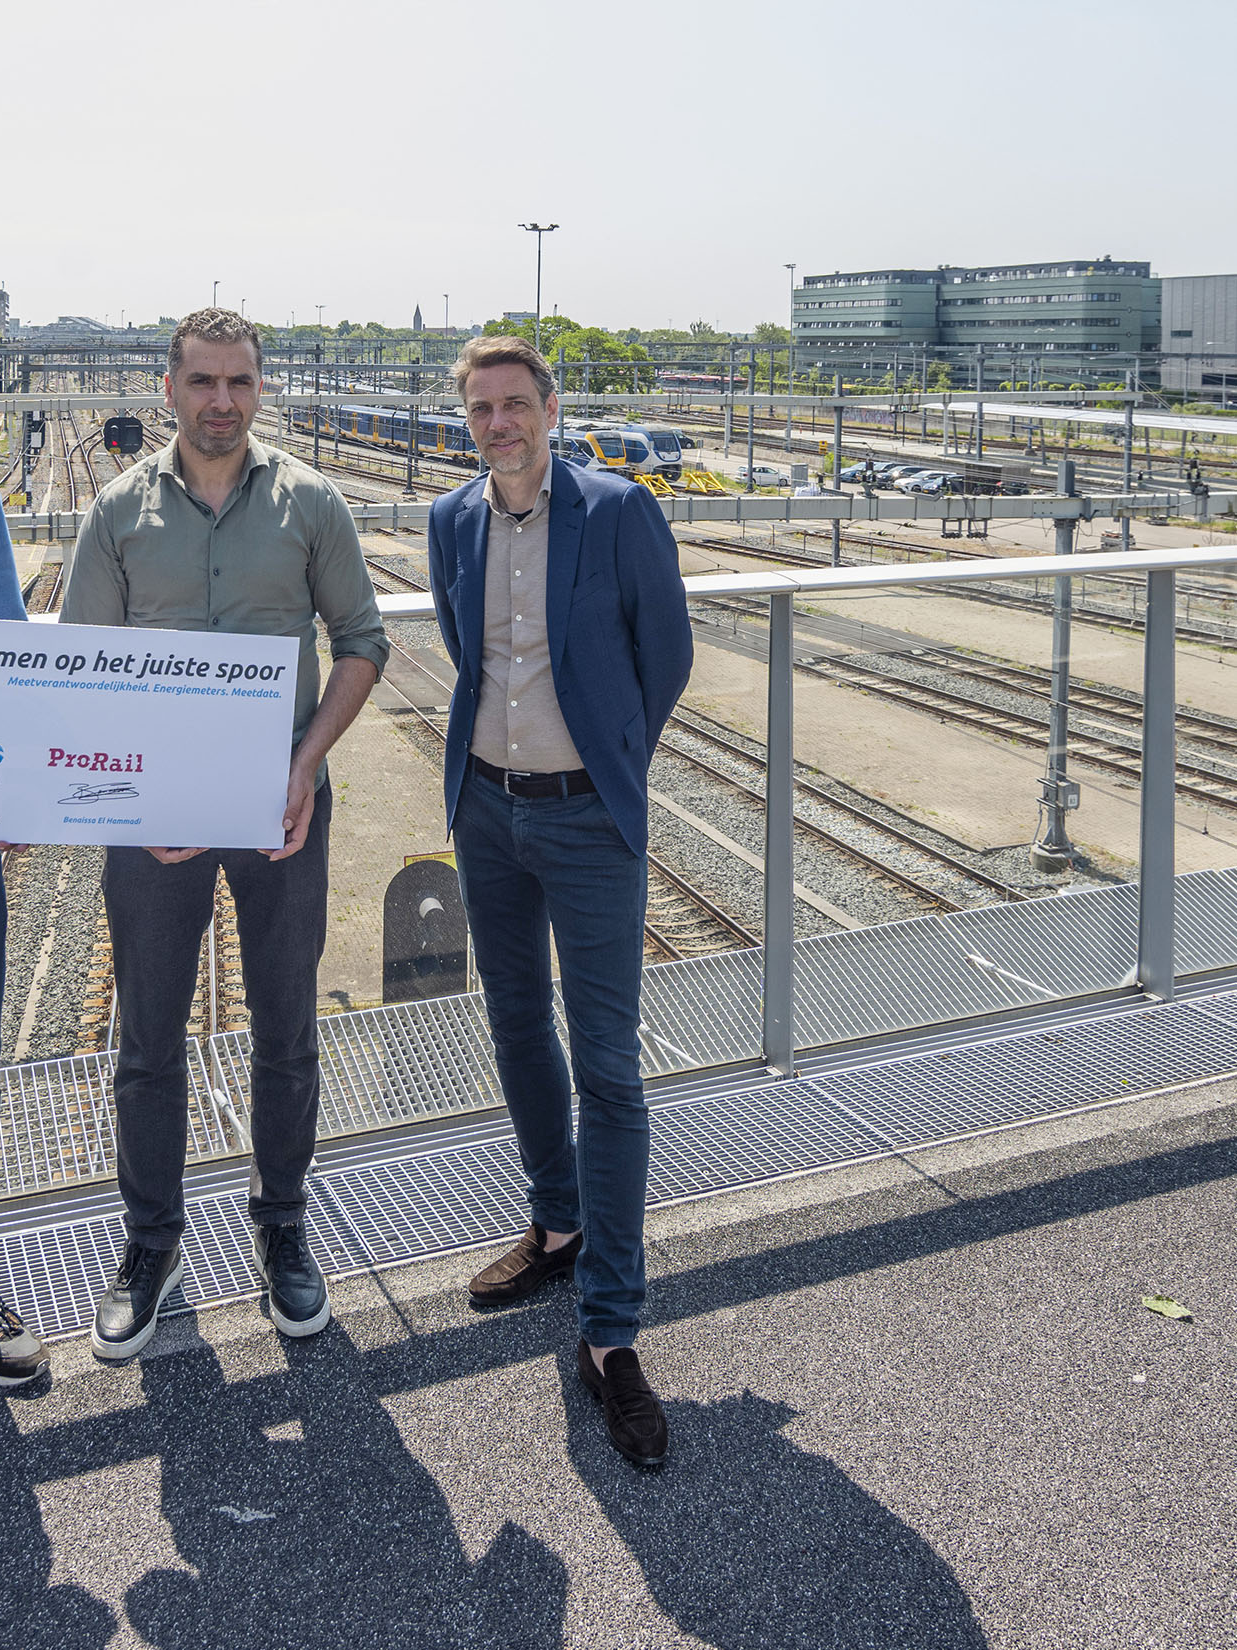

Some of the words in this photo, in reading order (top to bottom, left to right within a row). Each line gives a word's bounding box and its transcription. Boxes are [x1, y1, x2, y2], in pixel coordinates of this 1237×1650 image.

[55, 653, 86, 676] op
[92, 649, 136, 674] het
[135, 652, 211, 679] juiste
[214, 662, 286, 684] spoor
[7, 676, 151, 693] Meetverantwoordelijkheid.
[153, 683, 229, 696] Energiemeters.
[231, 687, 282, 699] Meetdata.
[47, 748, 144, 773] ProRail
[63, 816, 96, 825] Benaissa
[97, 816, 105, 825] El
[106, 817, 142, 825] Hammadi
